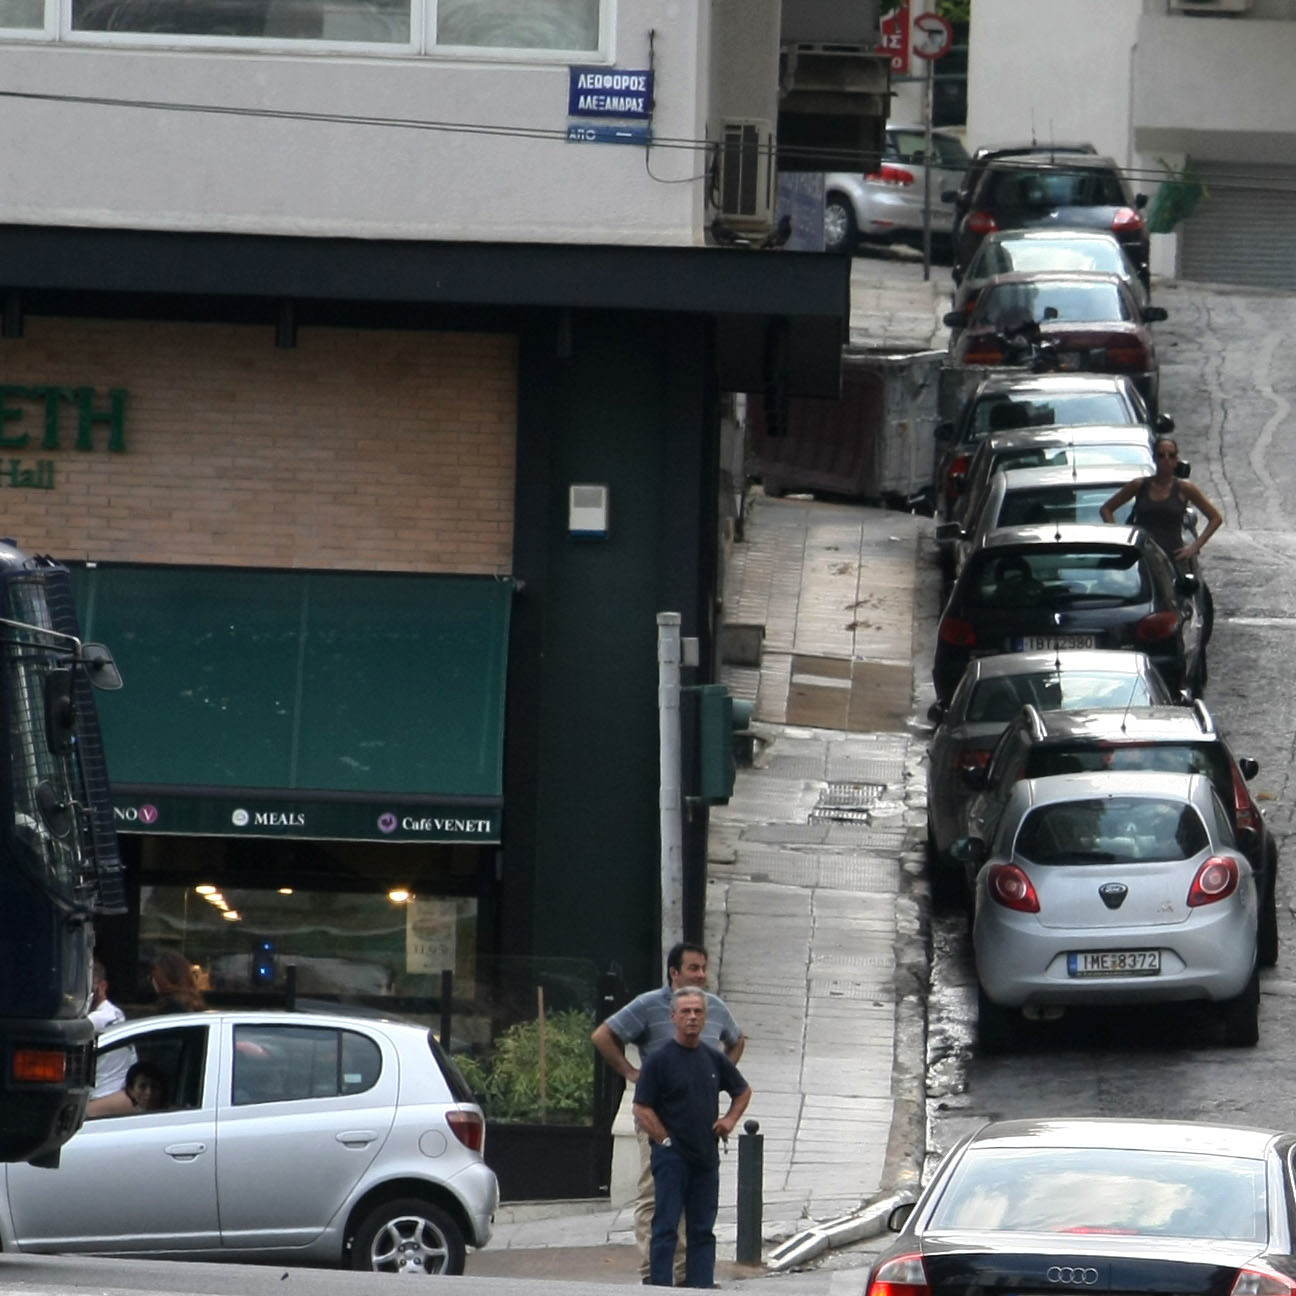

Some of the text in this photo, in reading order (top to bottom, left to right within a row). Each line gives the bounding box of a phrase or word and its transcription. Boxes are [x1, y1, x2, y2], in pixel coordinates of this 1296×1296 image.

[578, 73, 647, 92] ΛΕΩΦΟΡΟΣ
[578, 95, 645, 113] ΑΛΕΞΑΝΔΡΑΣ
[254, 812, 304, 826] MEALS
[402, 816, 433, 831] Café
